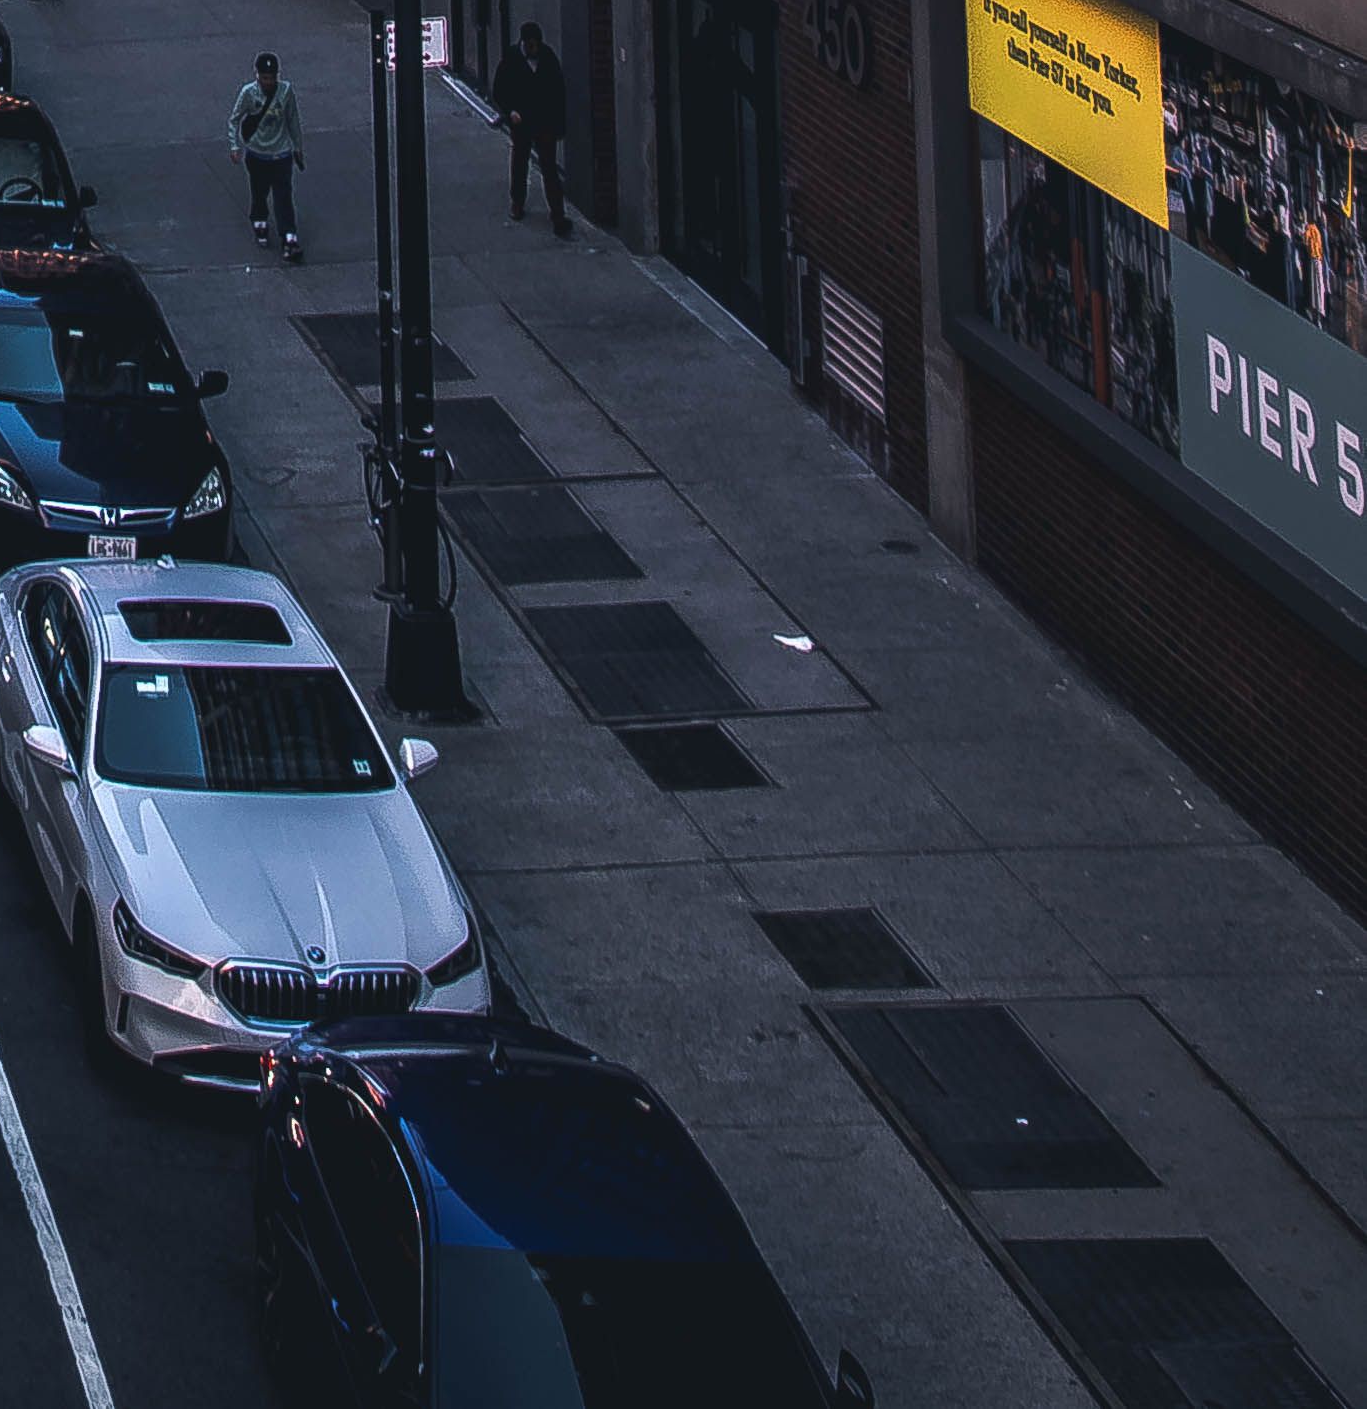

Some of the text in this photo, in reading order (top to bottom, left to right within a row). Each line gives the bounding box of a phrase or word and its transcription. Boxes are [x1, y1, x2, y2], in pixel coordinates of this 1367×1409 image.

[992, 1, 1009, 23] you
[1010, 9, 1027, 33] call
[1029, 21, 1067, 56] yourself
[1069, 43, 1075, 60] a
[1076, 40, 1100, 72] New
[1101, 53, 1141, 102] Yorker,
[1008, 37, 1115, 117] then Pier 57 is for you.
[1207, 333, 1365, 517] PIER 5
